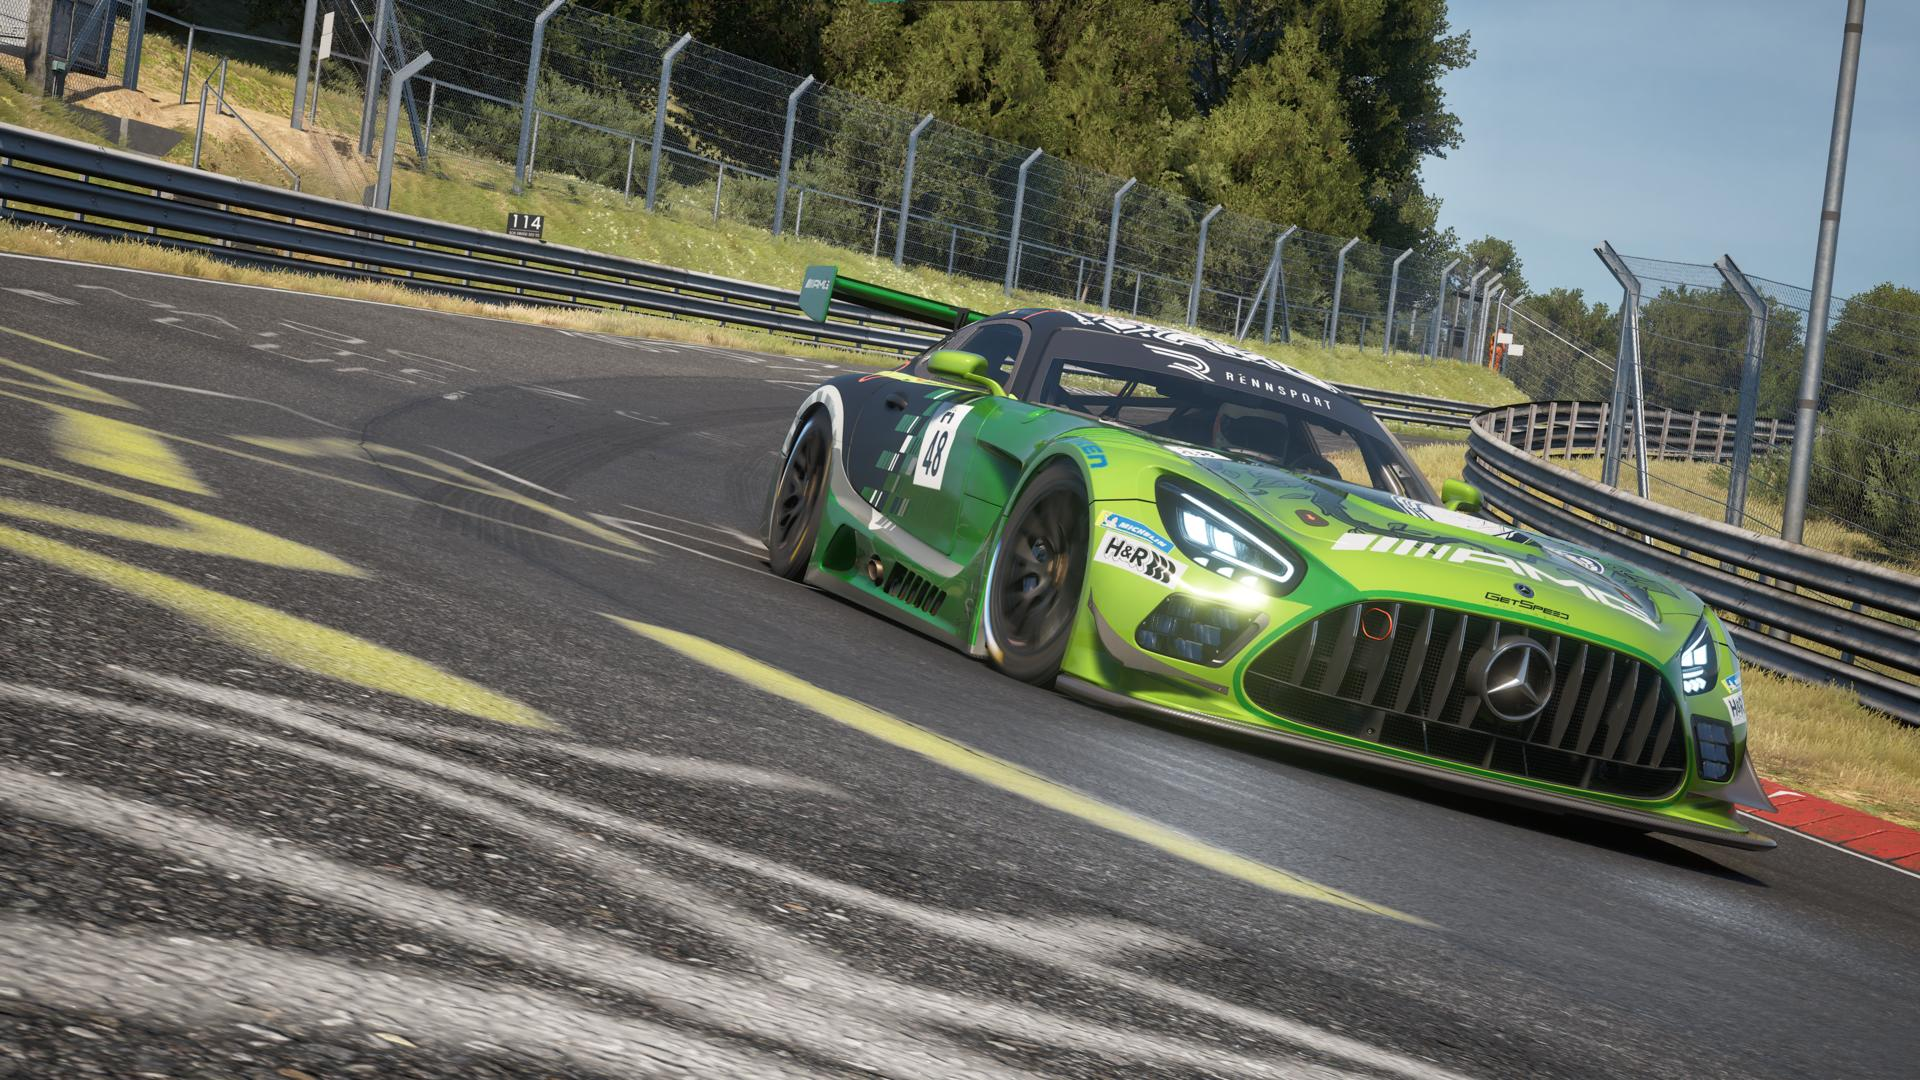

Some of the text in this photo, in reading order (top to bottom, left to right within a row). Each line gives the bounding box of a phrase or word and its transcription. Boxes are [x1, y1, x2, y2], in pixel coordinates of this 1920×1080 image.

[513, 214, 541, 230] 114
[1225, 371, 1331, 410] RENNSPORT
[922, 430, 949, 477] 48
[1118, 521, 1167, 547] MICHELIN
[1105, 537, 1149, 567] H&R
